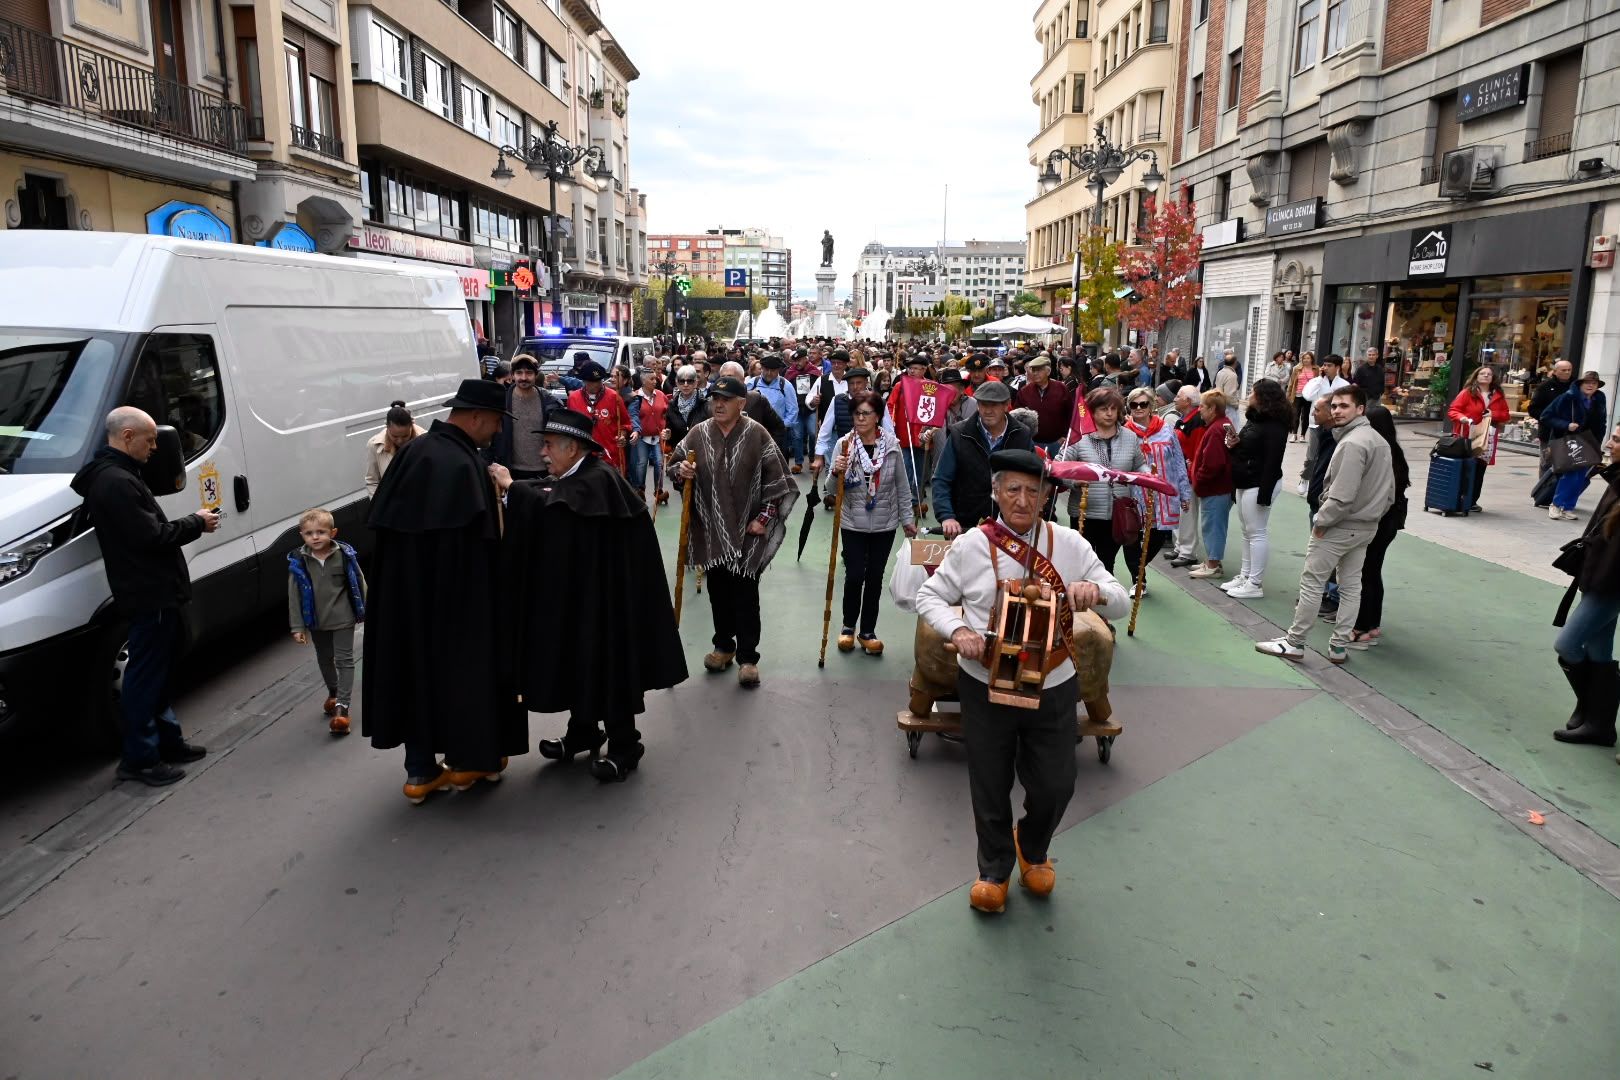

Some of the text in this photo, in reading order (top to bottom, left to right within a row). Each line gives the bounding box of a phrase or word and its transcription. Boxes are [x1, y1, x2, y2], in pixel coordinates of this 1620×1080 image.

[1479, 72, 1518, 94] CLINICA
[1477, 86, 1517, 107] DENTAL
[1295, 203, 1316, 218] DENTAL
[1435, 241, 1447, 257] 10
[730, 270, 741, 286] P
